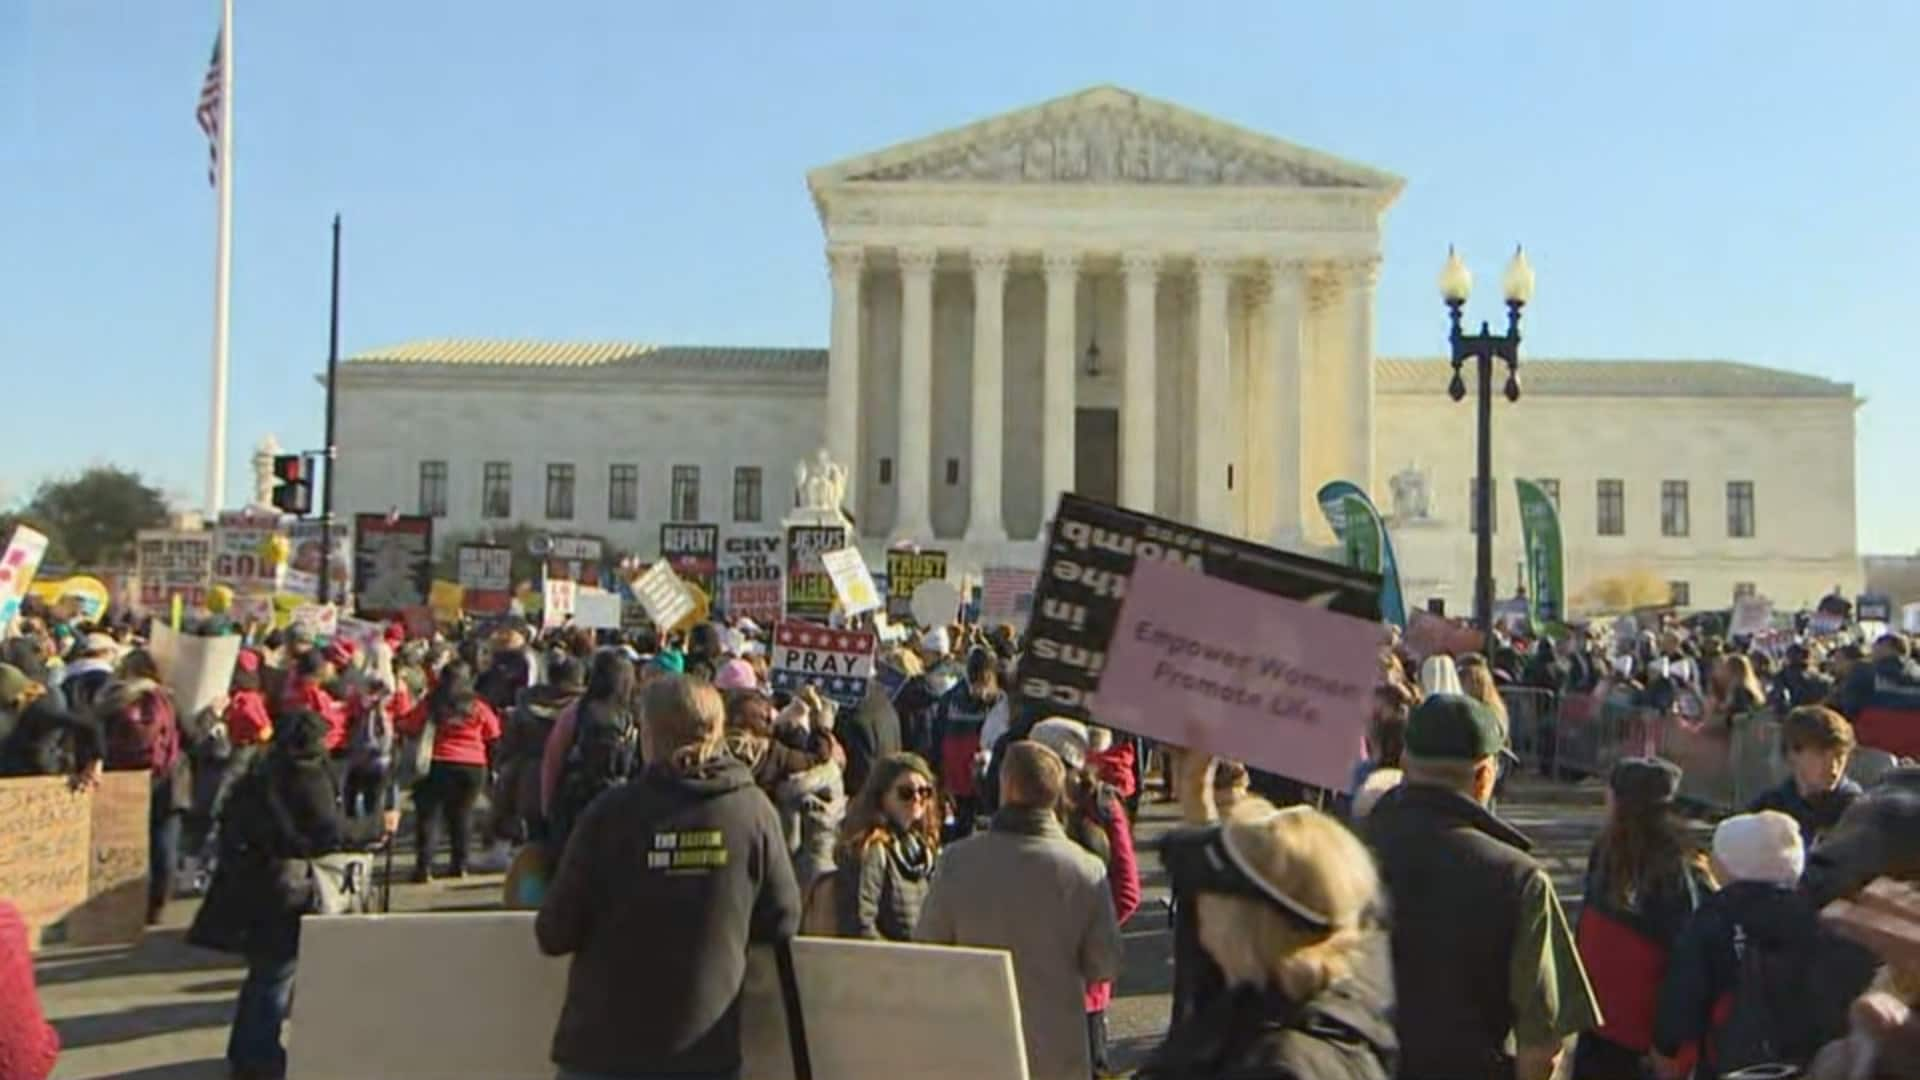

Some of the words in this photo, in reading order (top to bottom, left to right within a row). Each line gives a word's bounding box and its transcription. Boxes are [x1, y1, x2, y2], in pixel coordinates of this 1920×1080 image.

[793, 530, 843, 551] JESUS
[727, 565, 781, 582] GOD
[889, 554, 945, 577] TRUST
[1052, 559, 1126, 600] the
[1042, 598, 1087, 631] in
[785, 649, 857, 673] PRAY
[1134, 620, 1253, 668] Empower
[1259, 656, 1360, 697] Women
[1153, 661, 1262, 707] Promote
[1270, 696, 1319, 724] Life
